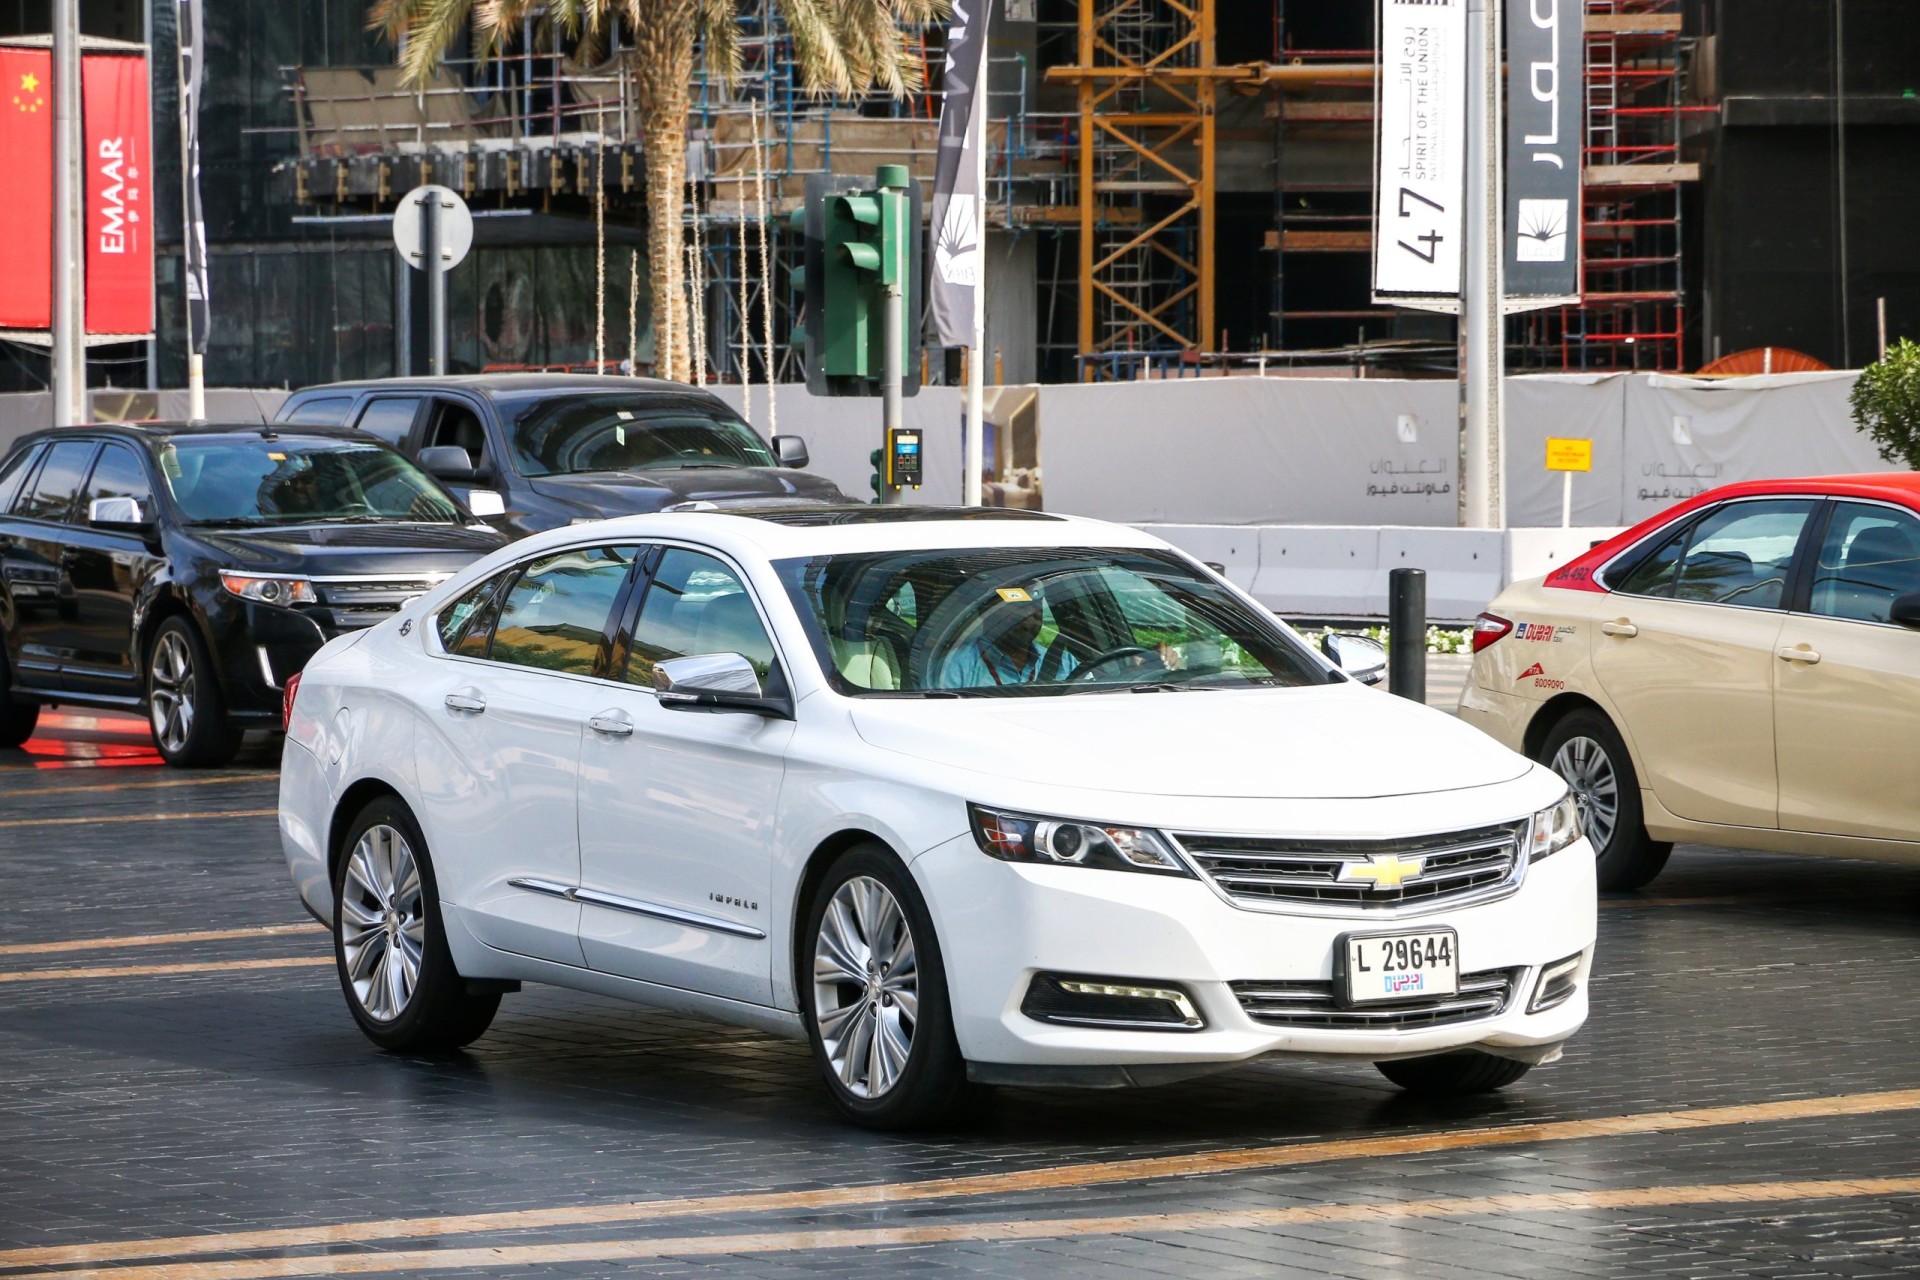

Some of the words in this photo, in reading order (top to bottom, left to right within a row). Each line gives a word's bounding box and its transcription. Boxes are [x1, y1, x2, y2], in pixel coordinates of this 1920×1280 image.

[1404, 26, 1416, 58] روح
[1418, 27, 1429, 73] UNION
[1417, 78, 1428, 106] THE
[1416, 110, 1428, 129] OF
[1430, 106, 1438, 126] DAY
[1415, 133, 1427, 180] SPIRIT
[1429, 129, 1438, 181] NATIONAL
[99, 136, 124, 254] EMAAR
[1397, 187, 1444, 264] 47
[1570, 566, 1590, 582] 492
[1535, 678, 1565, 690] 8009090
[709, 892, 759, 911] IMPALA
[1357, 944, 1372, 973] L
[1382, 936, 1452, 972] 29644
